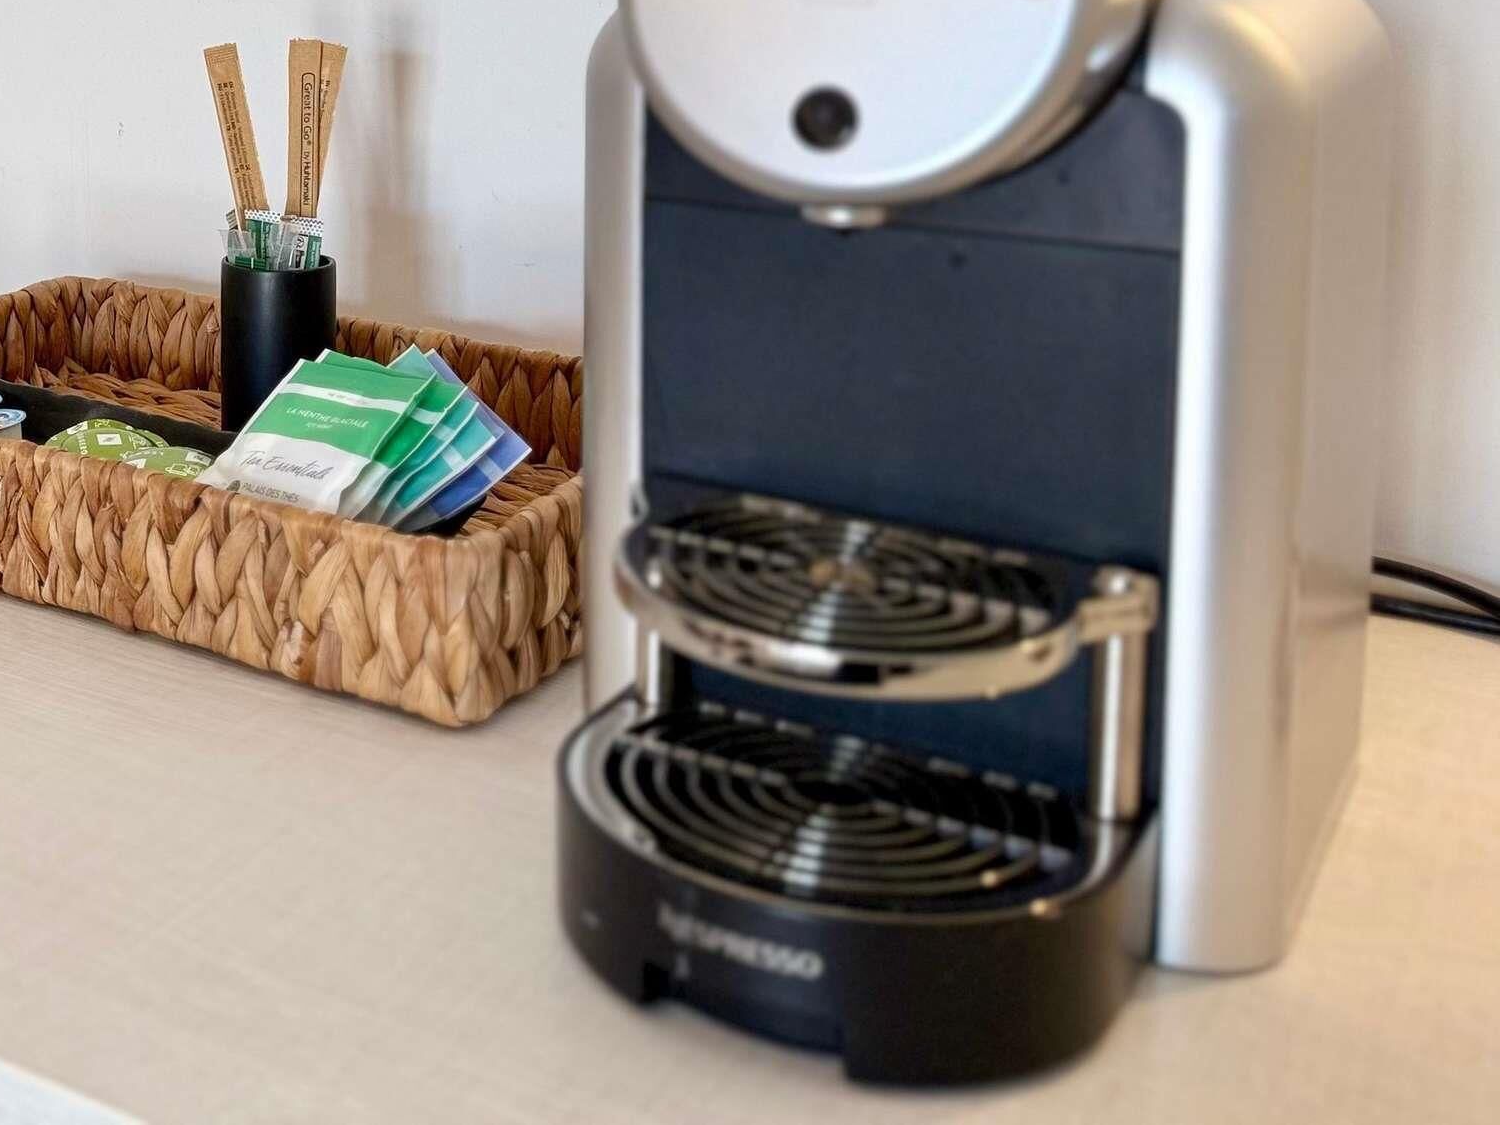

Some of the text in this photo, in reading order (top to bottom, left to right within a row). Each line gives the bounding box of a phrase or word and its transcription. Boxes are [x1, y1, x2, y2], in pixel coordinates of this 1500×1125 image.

[304, 82, 312, 109] Great
[304, 110, 311, 122] to
[303, 151, 311, 162] by
[302, 162, 311, 206] Huhtamaki
